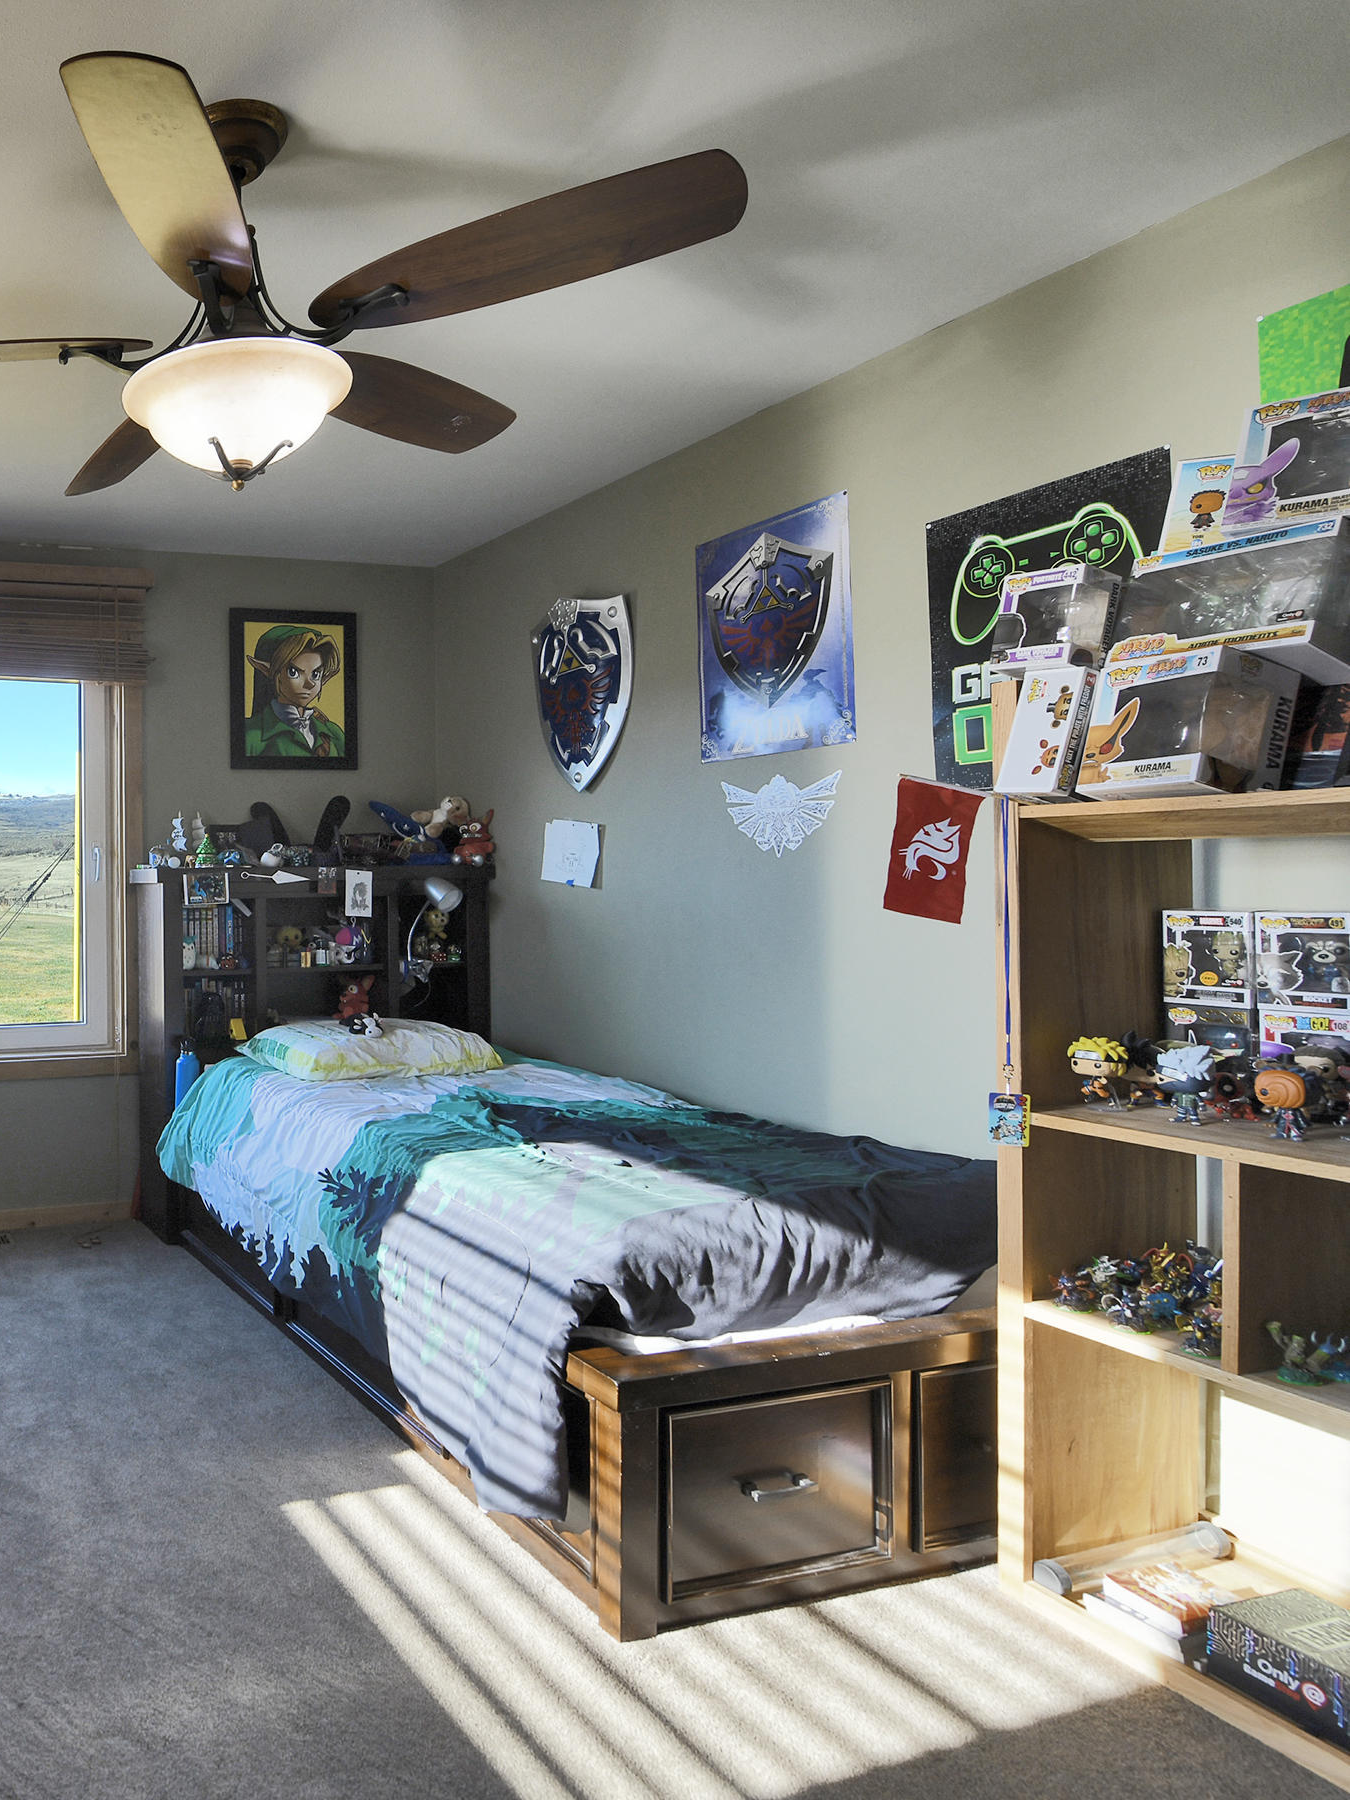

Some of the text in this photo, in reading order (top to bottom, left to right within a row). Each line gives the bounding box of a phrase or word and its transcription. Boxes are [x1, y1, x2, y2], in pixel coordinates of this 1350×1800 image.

[1279, 498, 1329, 513] KURAMA
[1186, 542, 1224, 557] SASUKE
[1226, 539, 1242, 549] VS.
[1245, 530, 1288, 545] NARUTO
[1108, 582, 1120, 608] DARK
[1187, 631, 1279, 649] ANIME MOMENTS
[1197, 656, 1209, 666] 73
[1266, 696, 1292, 769] KURAMA
[1134, 762, 1171, 773] KURAMA
[1330, 919, 1344, 927] 491
[1311, 1016, 1330, 1031] GO!
[1333, 1021, 1348, 1031] 108
[1257, 1658, 1301, 1691] Only
